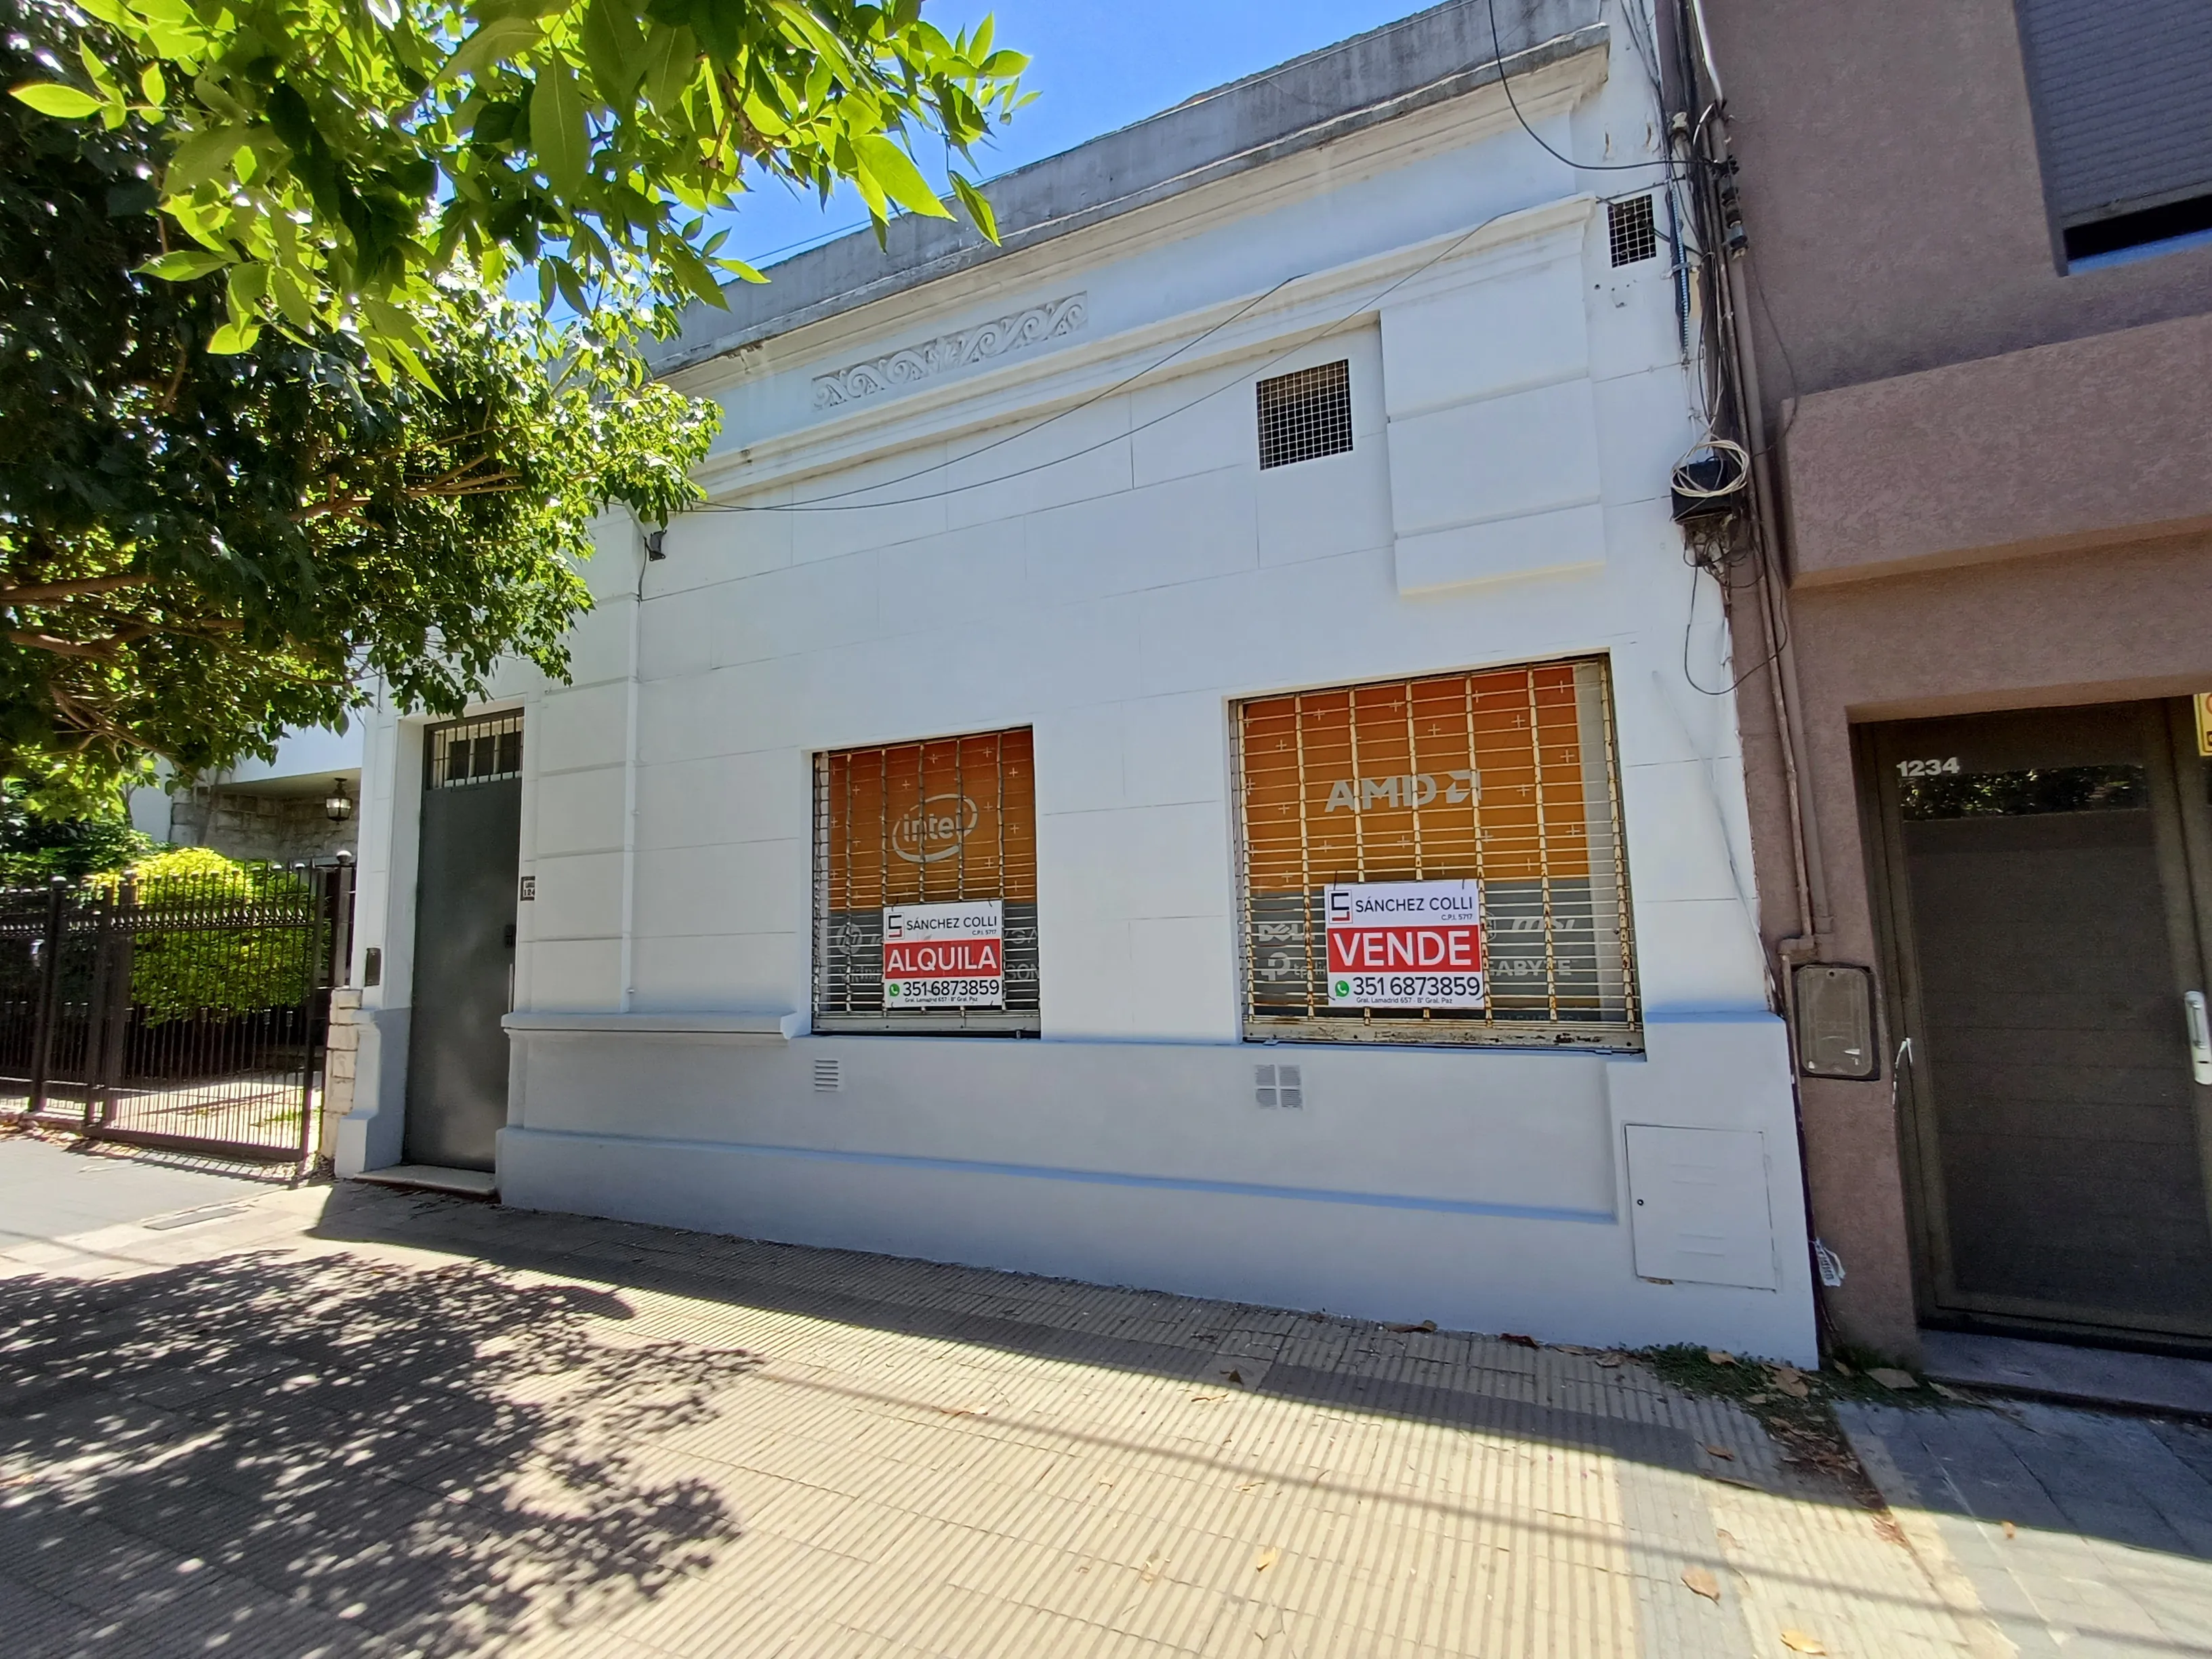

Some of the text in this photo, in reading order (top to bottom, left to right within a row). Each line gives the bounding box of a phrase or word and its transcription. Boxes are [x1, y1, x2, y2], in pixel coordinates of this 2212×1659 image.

[1896, 757, 1960, 777] 1234
[1324, 775, 1437, 813] AMD
[1355, 897, 1473, 912] SÁNCHEZ COLLI
[907, 916, 997, 930] SÁNCHEZ COLLI
[887, 945, 997, 972] ALQUILA
[1332, 931, 1471, 966] VENDE
